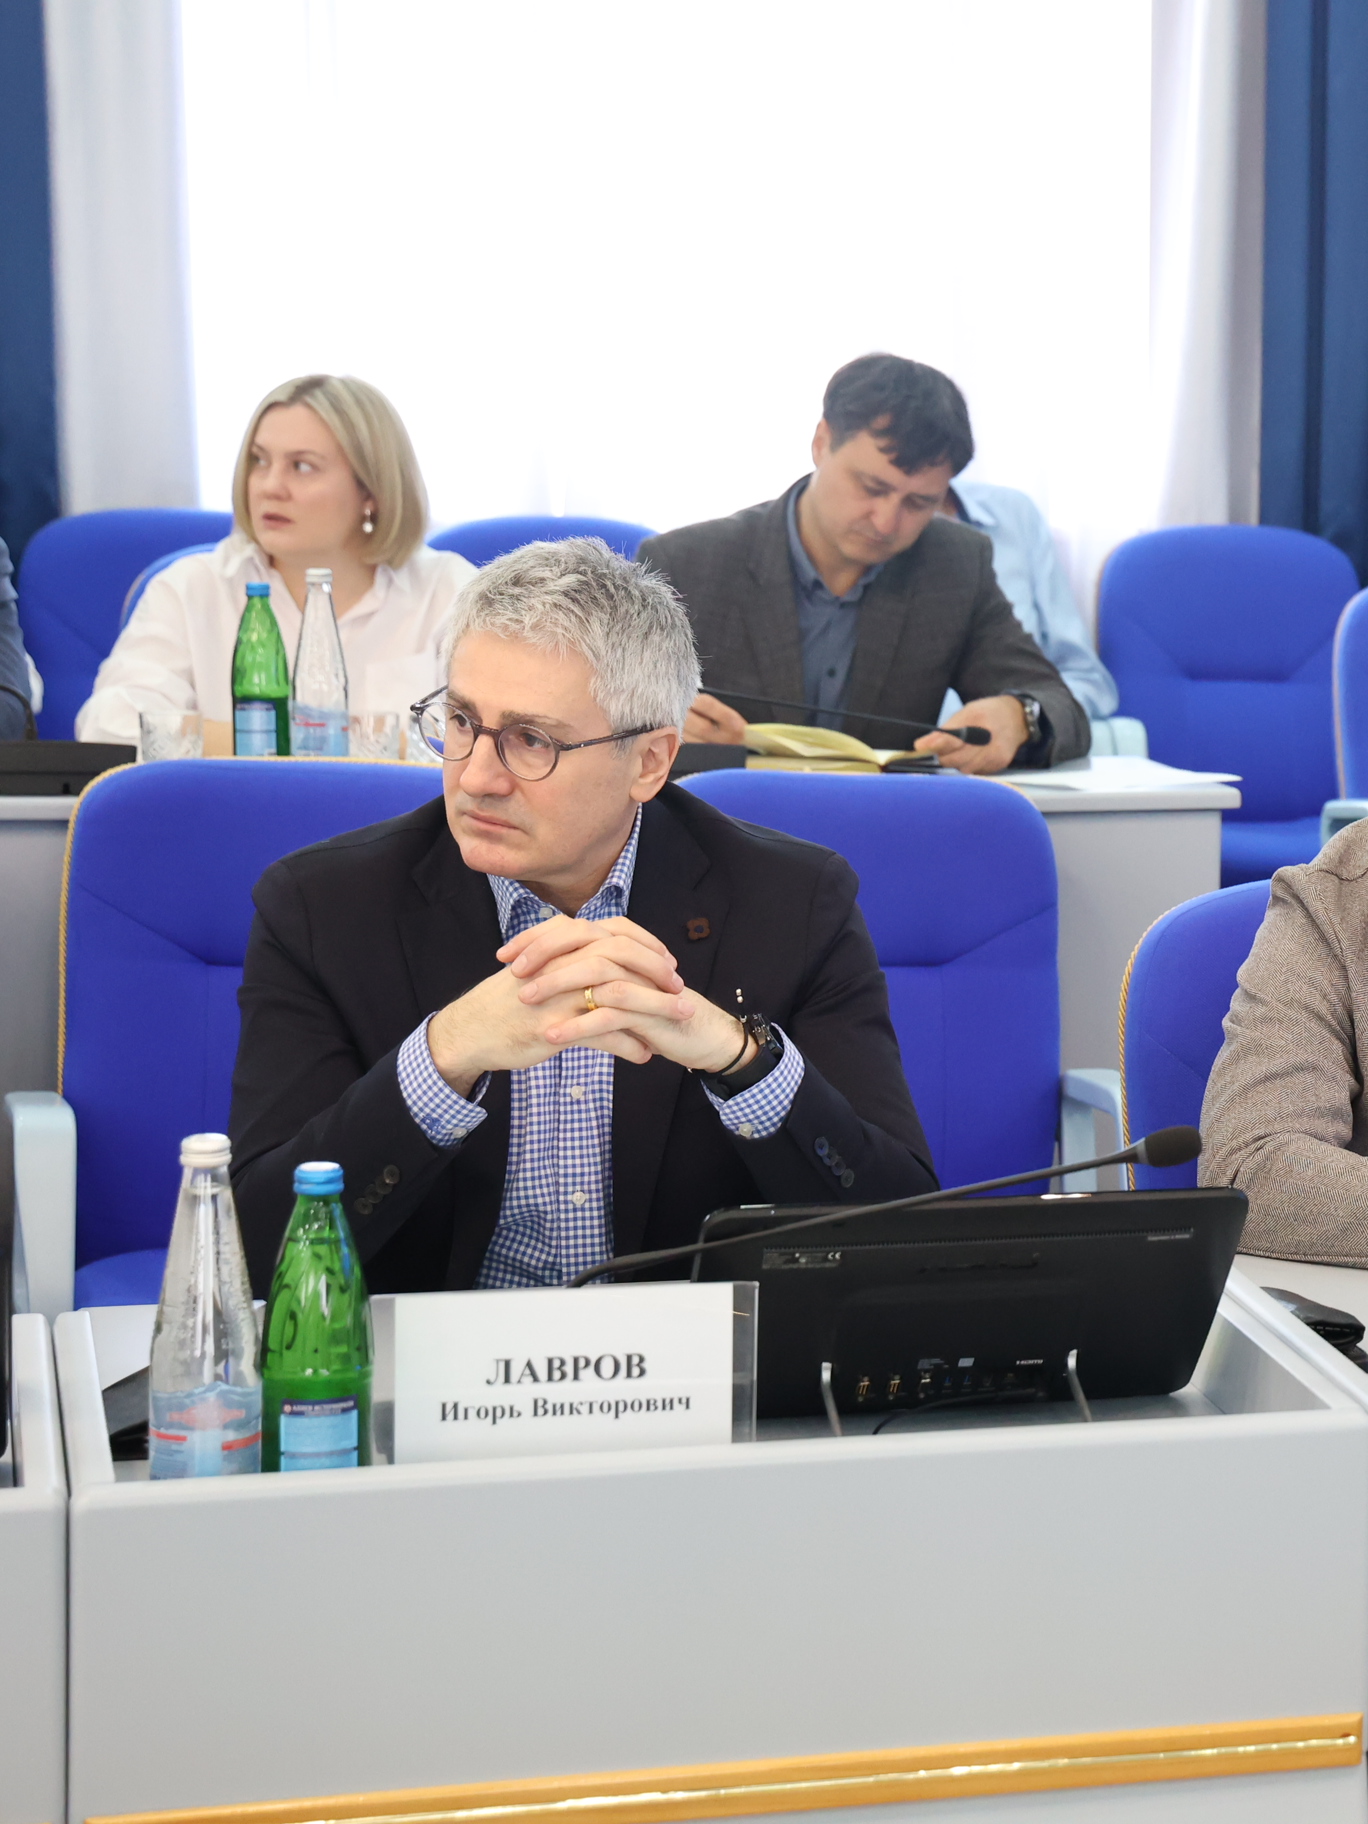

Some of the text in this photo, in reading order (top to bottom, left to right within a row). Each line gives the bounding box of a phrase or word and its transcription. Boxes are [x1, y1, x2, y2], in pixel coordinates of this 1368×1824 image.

[485, 1353, 647, 1386] ЛАВРОВ
[440, 1396, 691, 1426] Игорь Викторович
